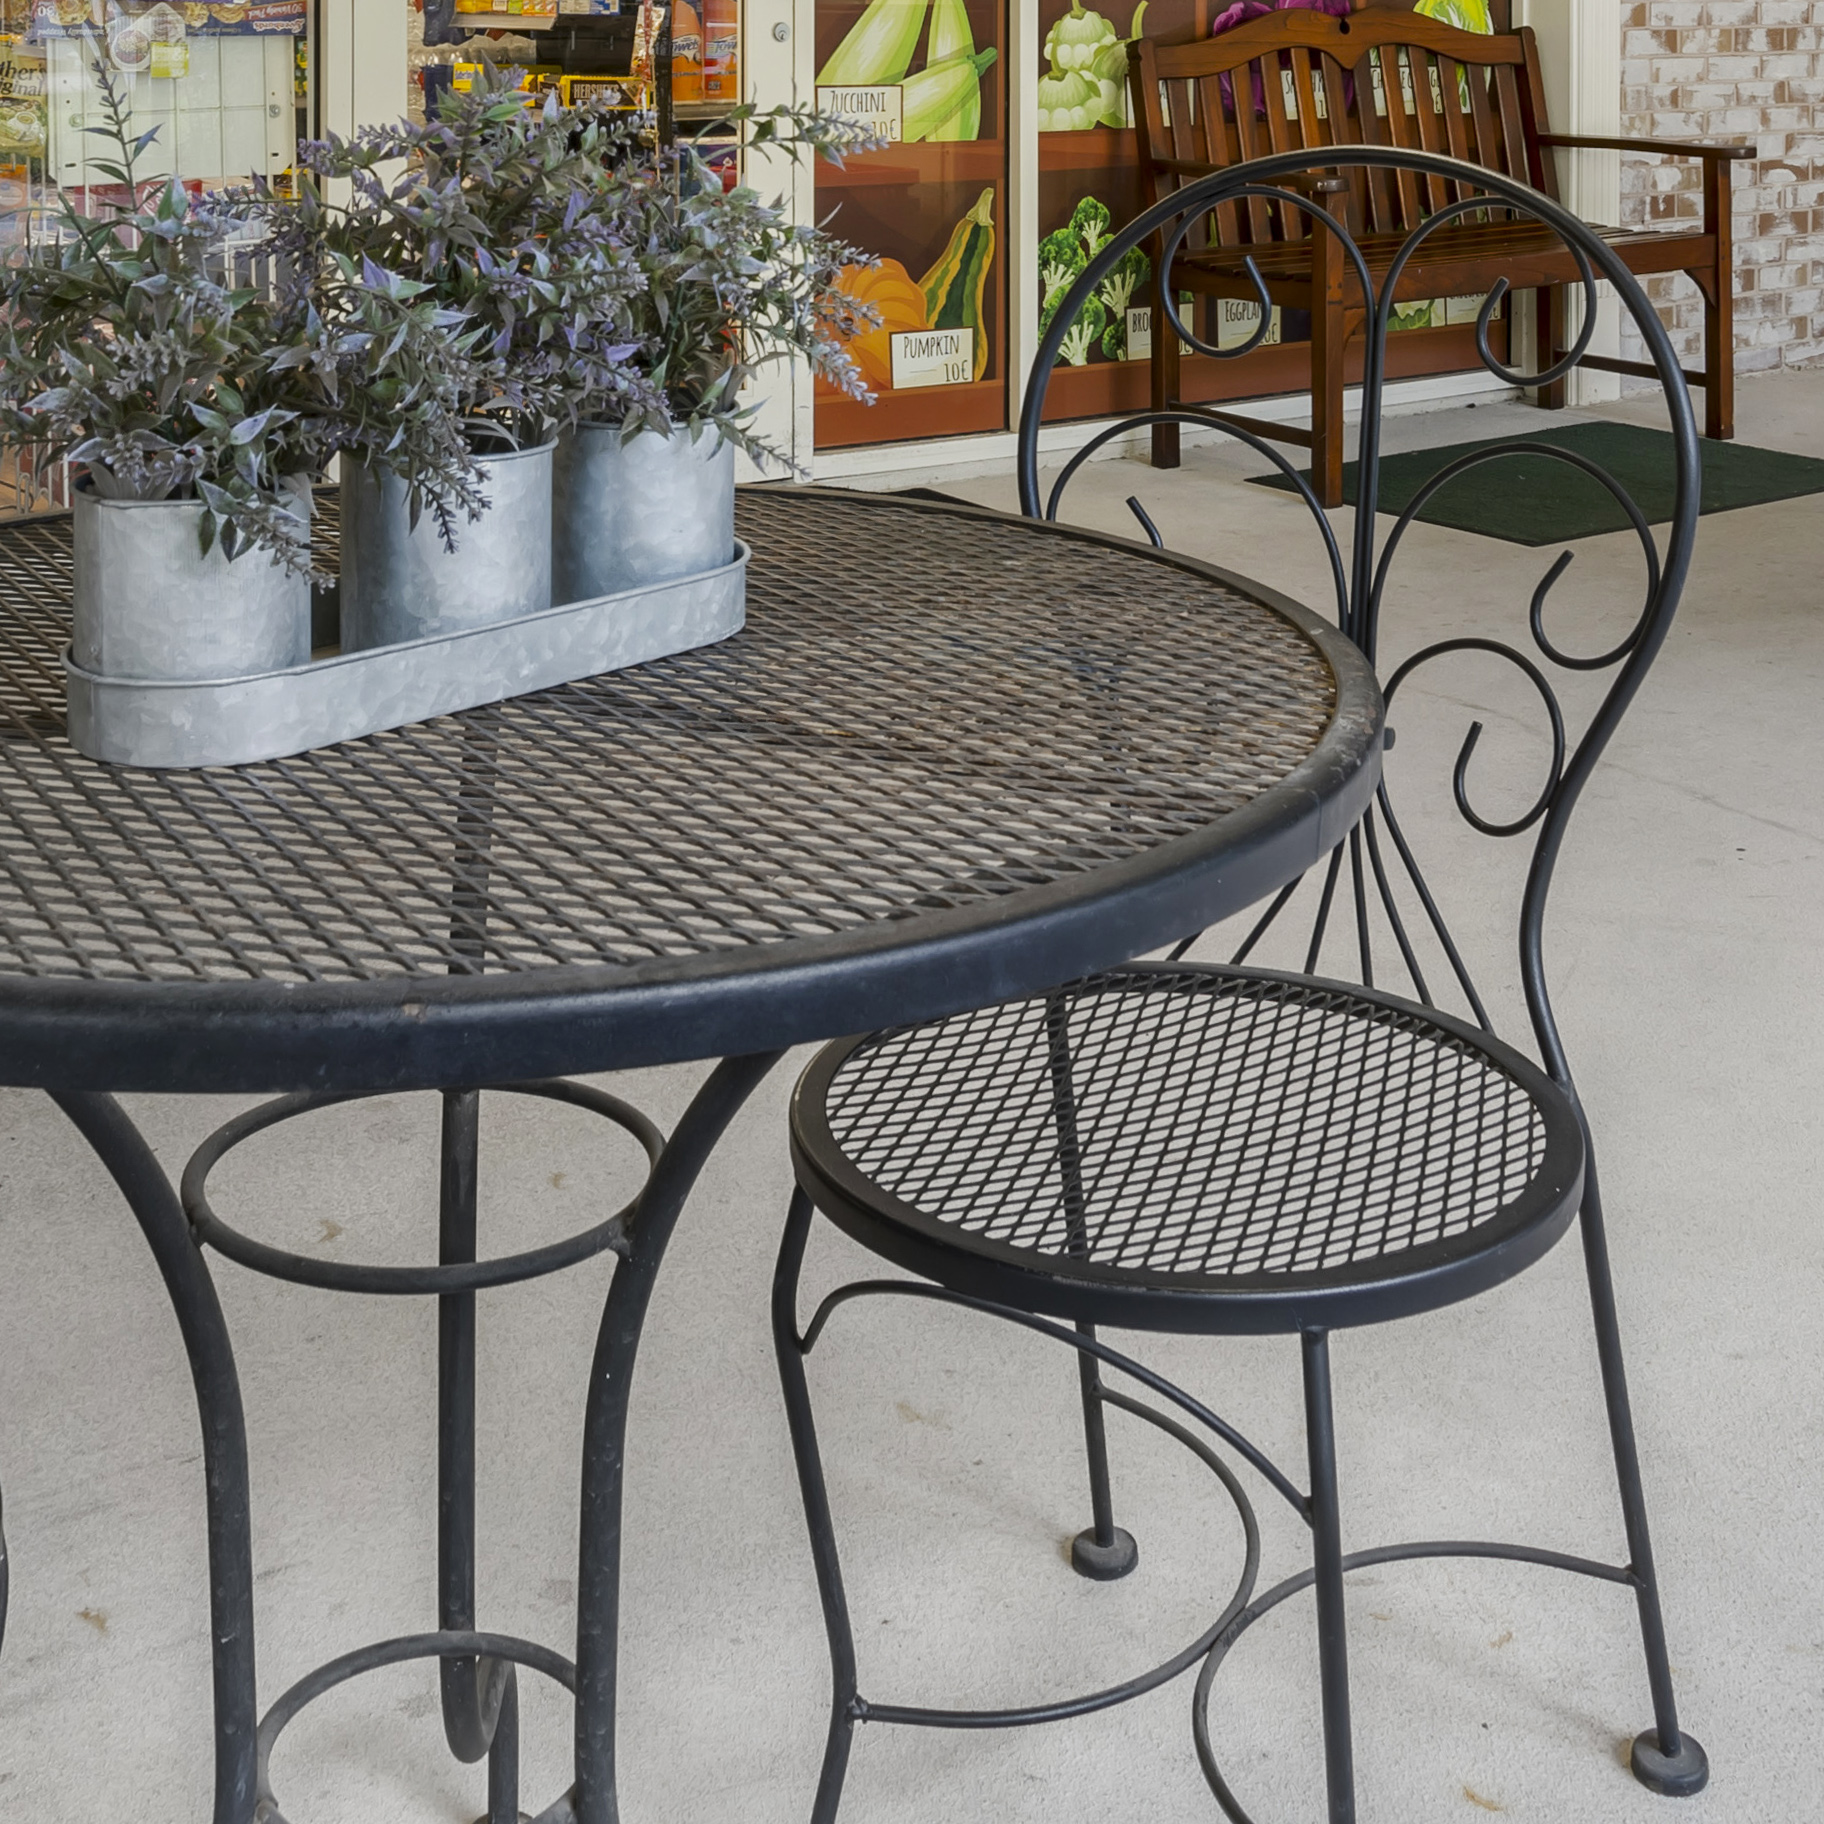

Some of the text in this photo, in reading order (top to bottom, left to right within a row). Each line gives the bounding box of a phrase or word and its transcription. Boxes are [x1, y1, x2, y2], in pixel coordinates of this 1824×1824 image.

[830, 90, 886, 114] ZUCCHINI
[903, 335, 960, 359] PUMPKIN
[944, 359, 969, 382] 10€
